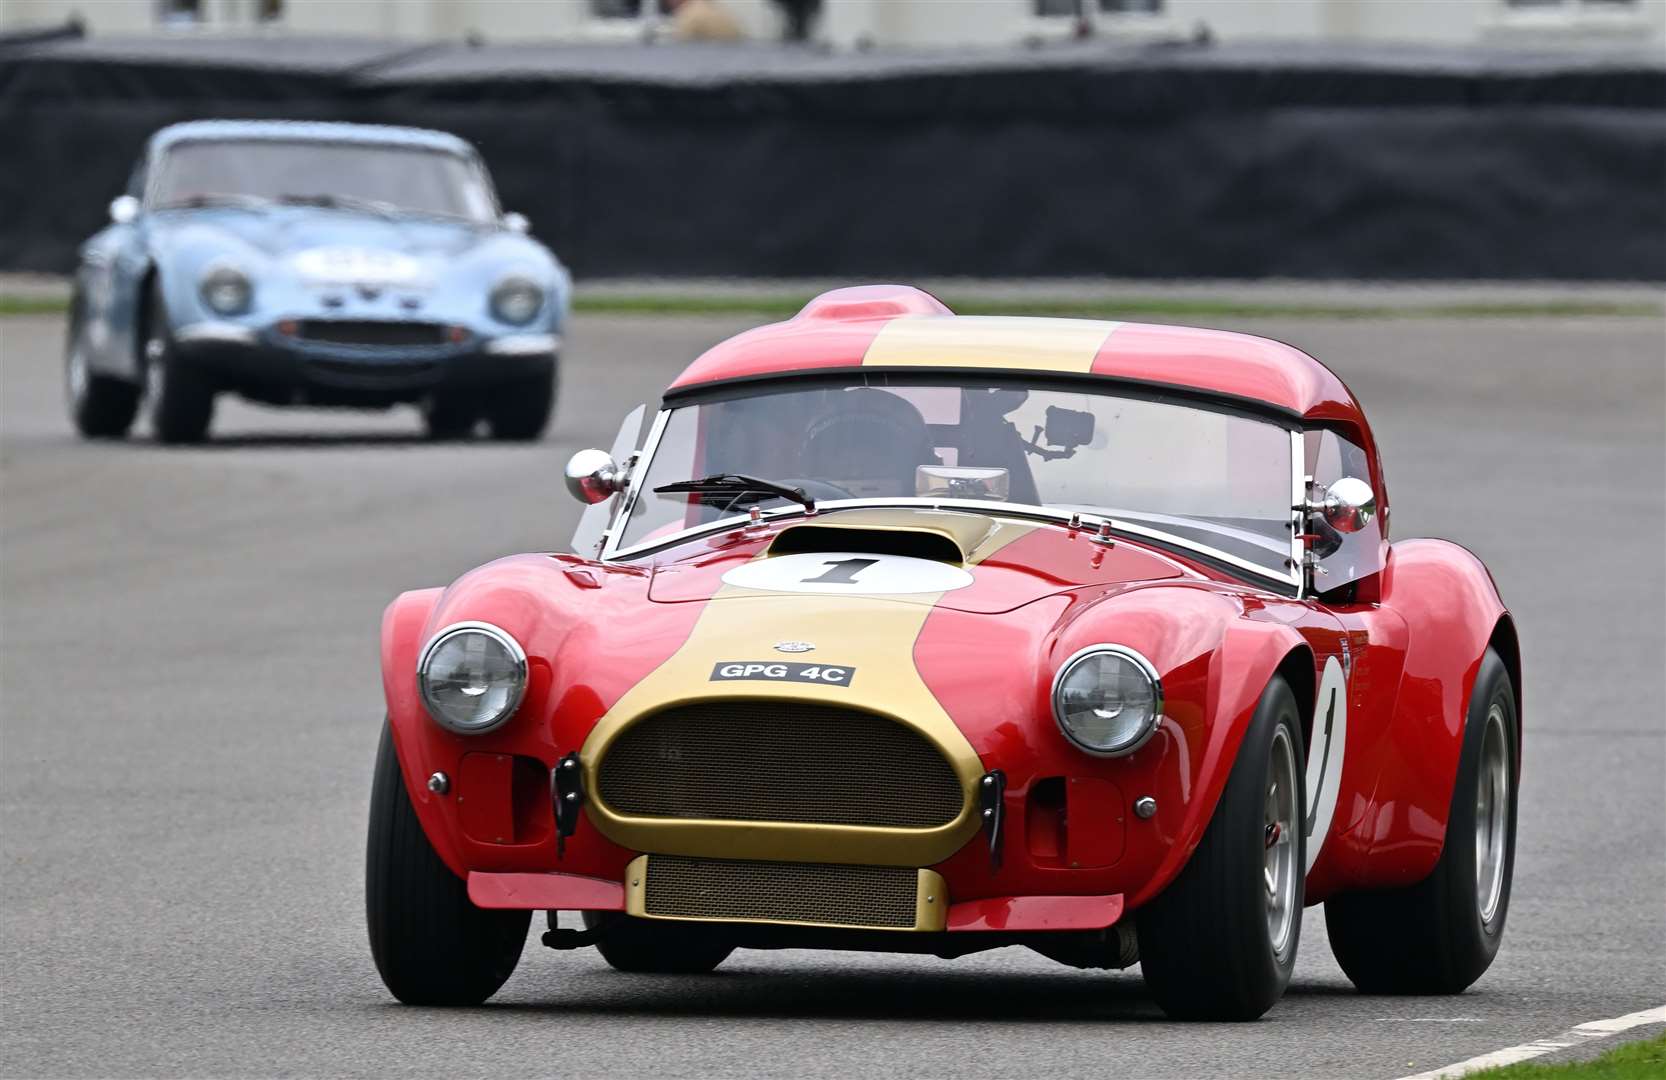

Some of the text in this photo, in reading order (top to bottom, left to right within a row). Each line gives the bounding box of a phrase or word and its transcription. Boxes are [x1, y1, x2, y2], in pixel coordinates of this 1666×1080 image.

[800, 558, 880, 584] 1
[719, 664, 846, 681] GPG 4C
[1305, 687, 1337, 837] 1
